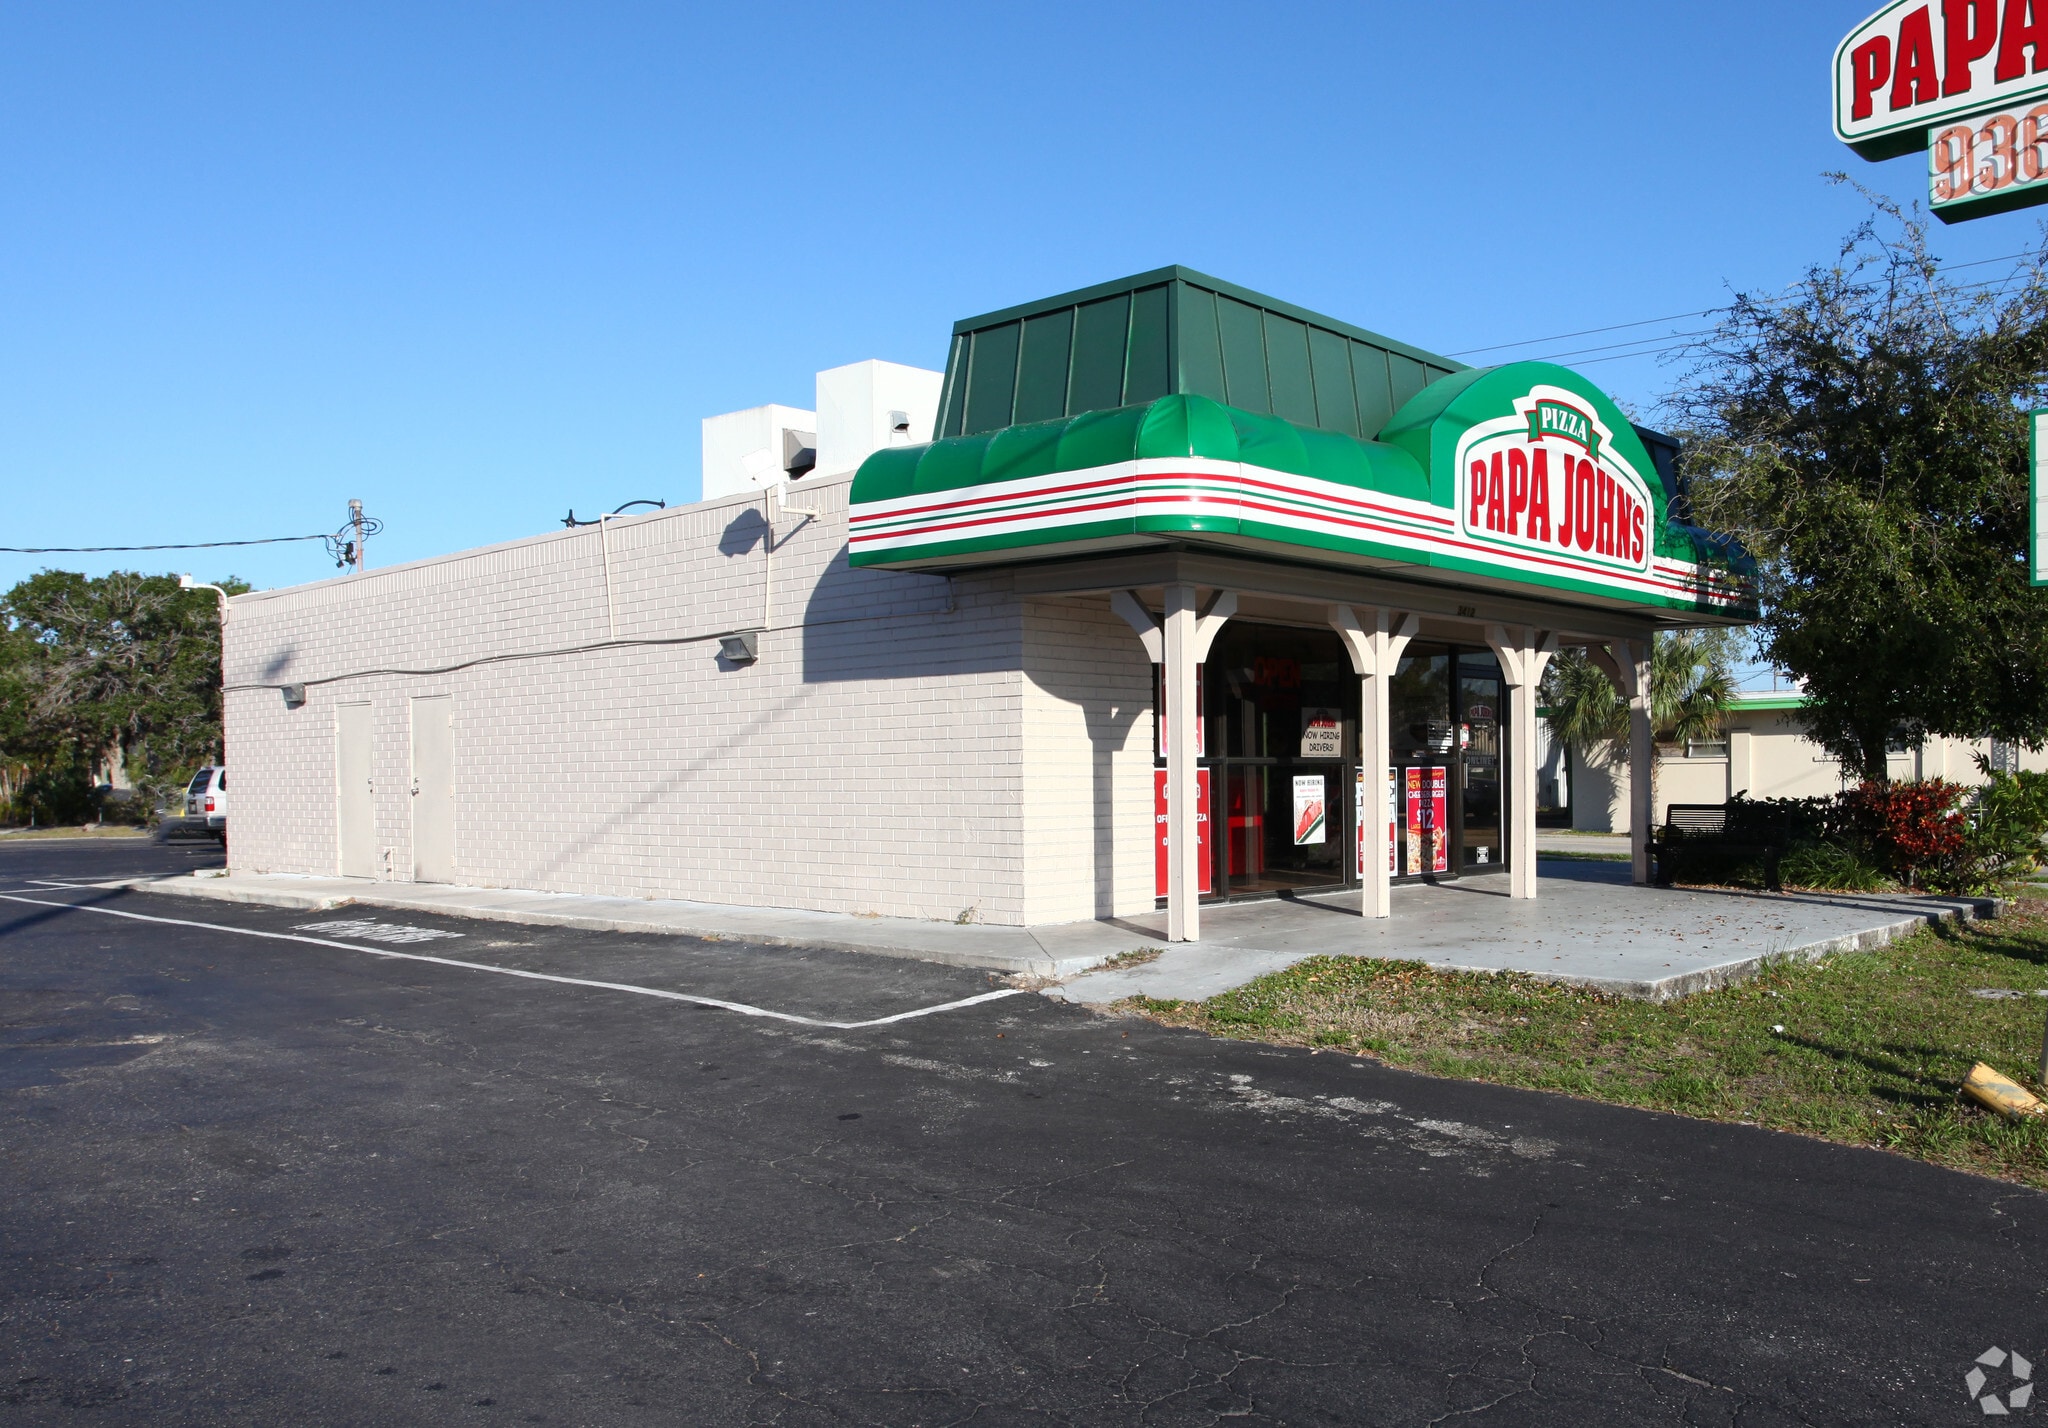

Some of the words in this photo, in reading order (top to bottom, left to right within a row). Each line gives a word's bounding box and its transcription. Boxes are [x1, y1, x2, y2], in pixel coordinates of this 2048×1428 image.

[1850, 0, 2048, 122] PAPA
[1541, 406, 1587, 442] PIZZA
[1470, 447, 1552, 543] PAPA
[1558, 453, 1645, 564] JOHN'S
[1254, 656, 1301, 688] OPEN
[1303, 730, 1319, 740] NOW
[1320, 731, 1340, 740] HIRING
[1408, 780, 1421, 789] NEW
[1422, 780, 1445, 789] DOUBLE
[1408, 790, 1445, 798] CHEESEBURGER
[1418, 799, 1434, 807] PIZZA
[1417, 808, 1434, 828] $12
